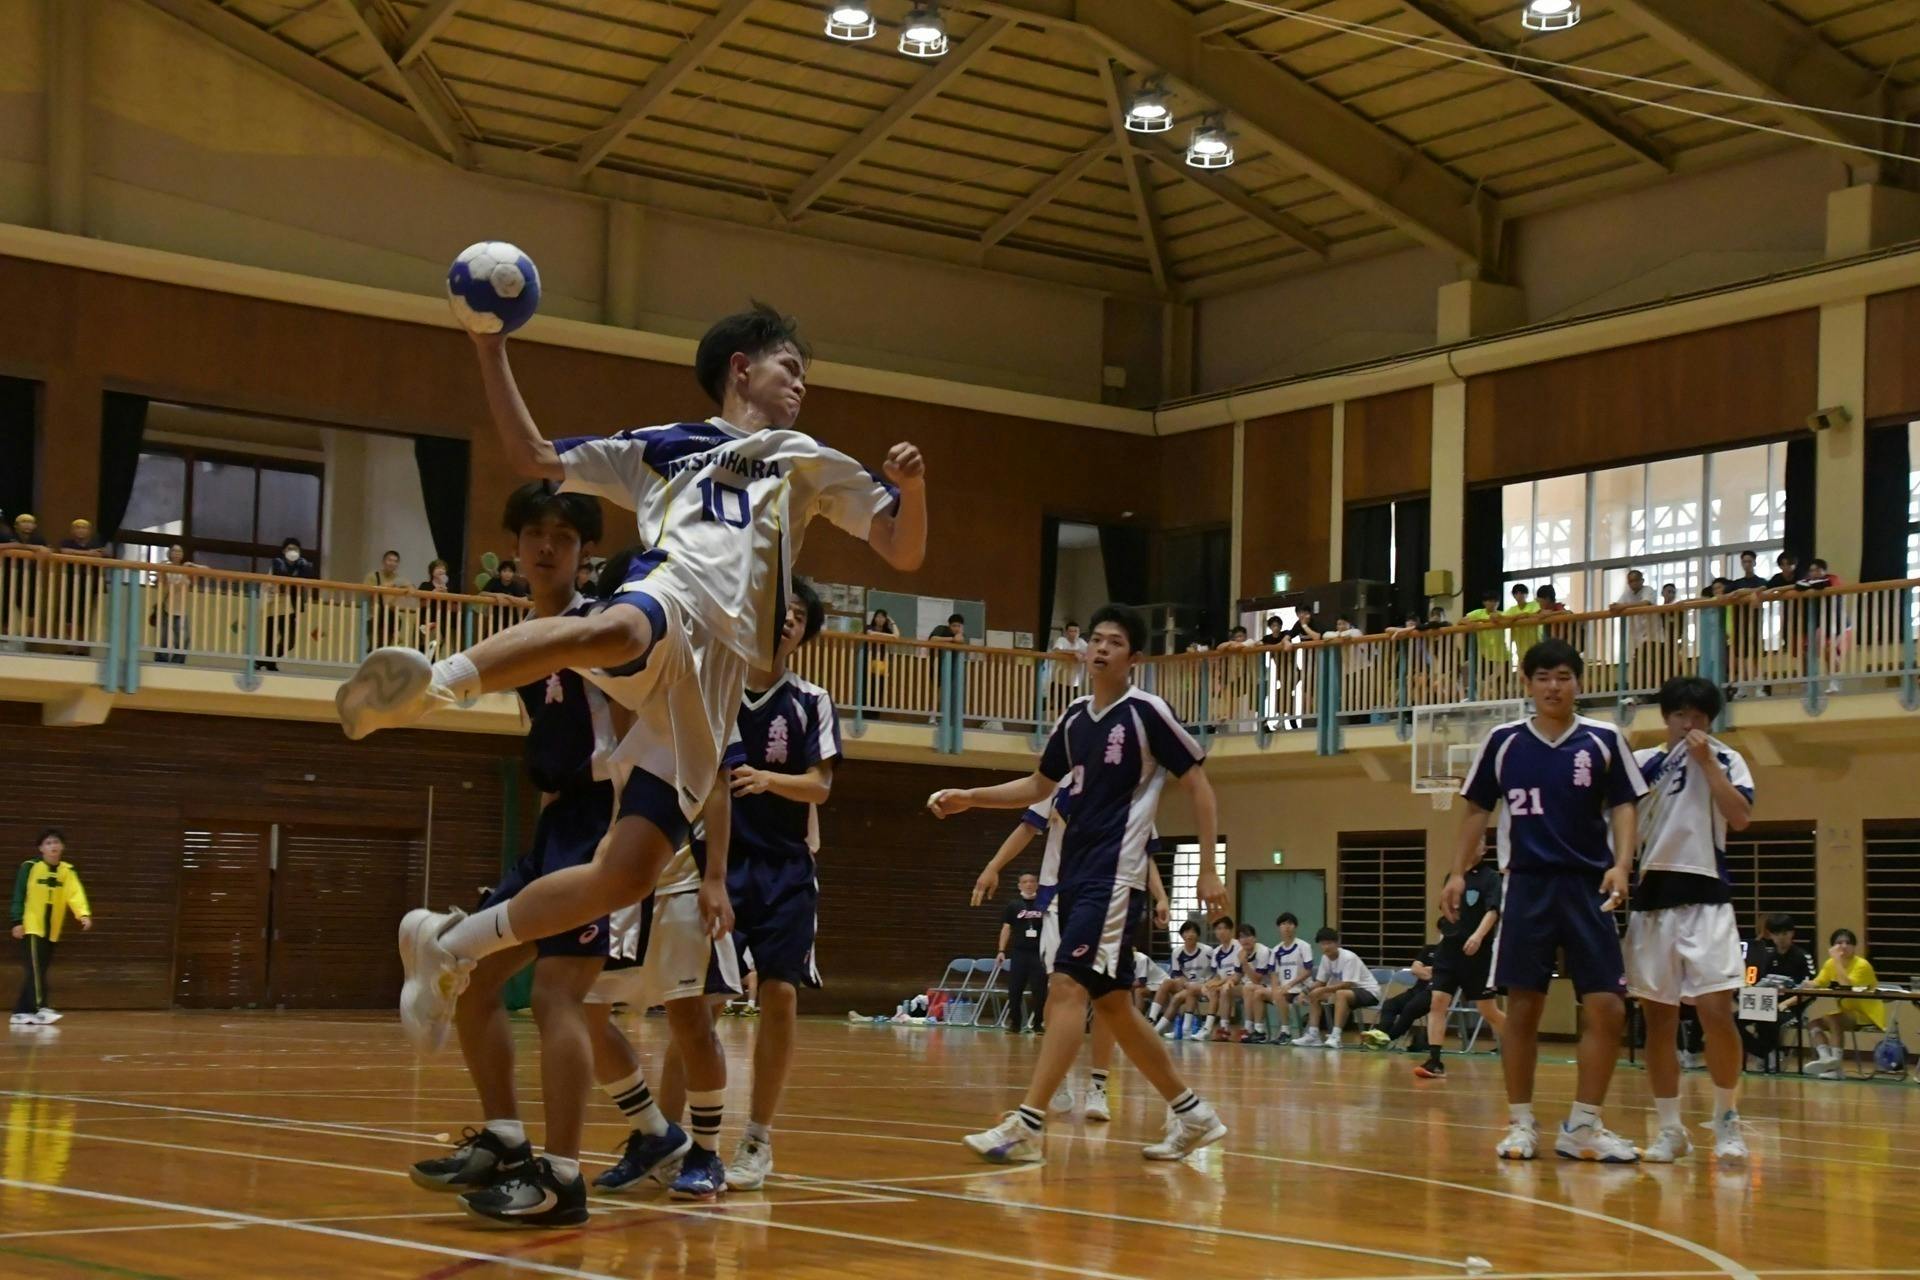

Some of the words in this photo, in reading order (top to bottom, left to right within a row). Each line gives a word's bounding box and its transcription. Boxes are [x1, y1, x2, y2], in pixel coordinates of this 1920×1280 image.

[697, 477, 751, 529] 10
[1668, 765, 1687, 796] 3
[1507, 787, 1544, 816] 21
[1745, 966, 1758, 984] 8
[1743, 993, 1775, 1012] 西原
